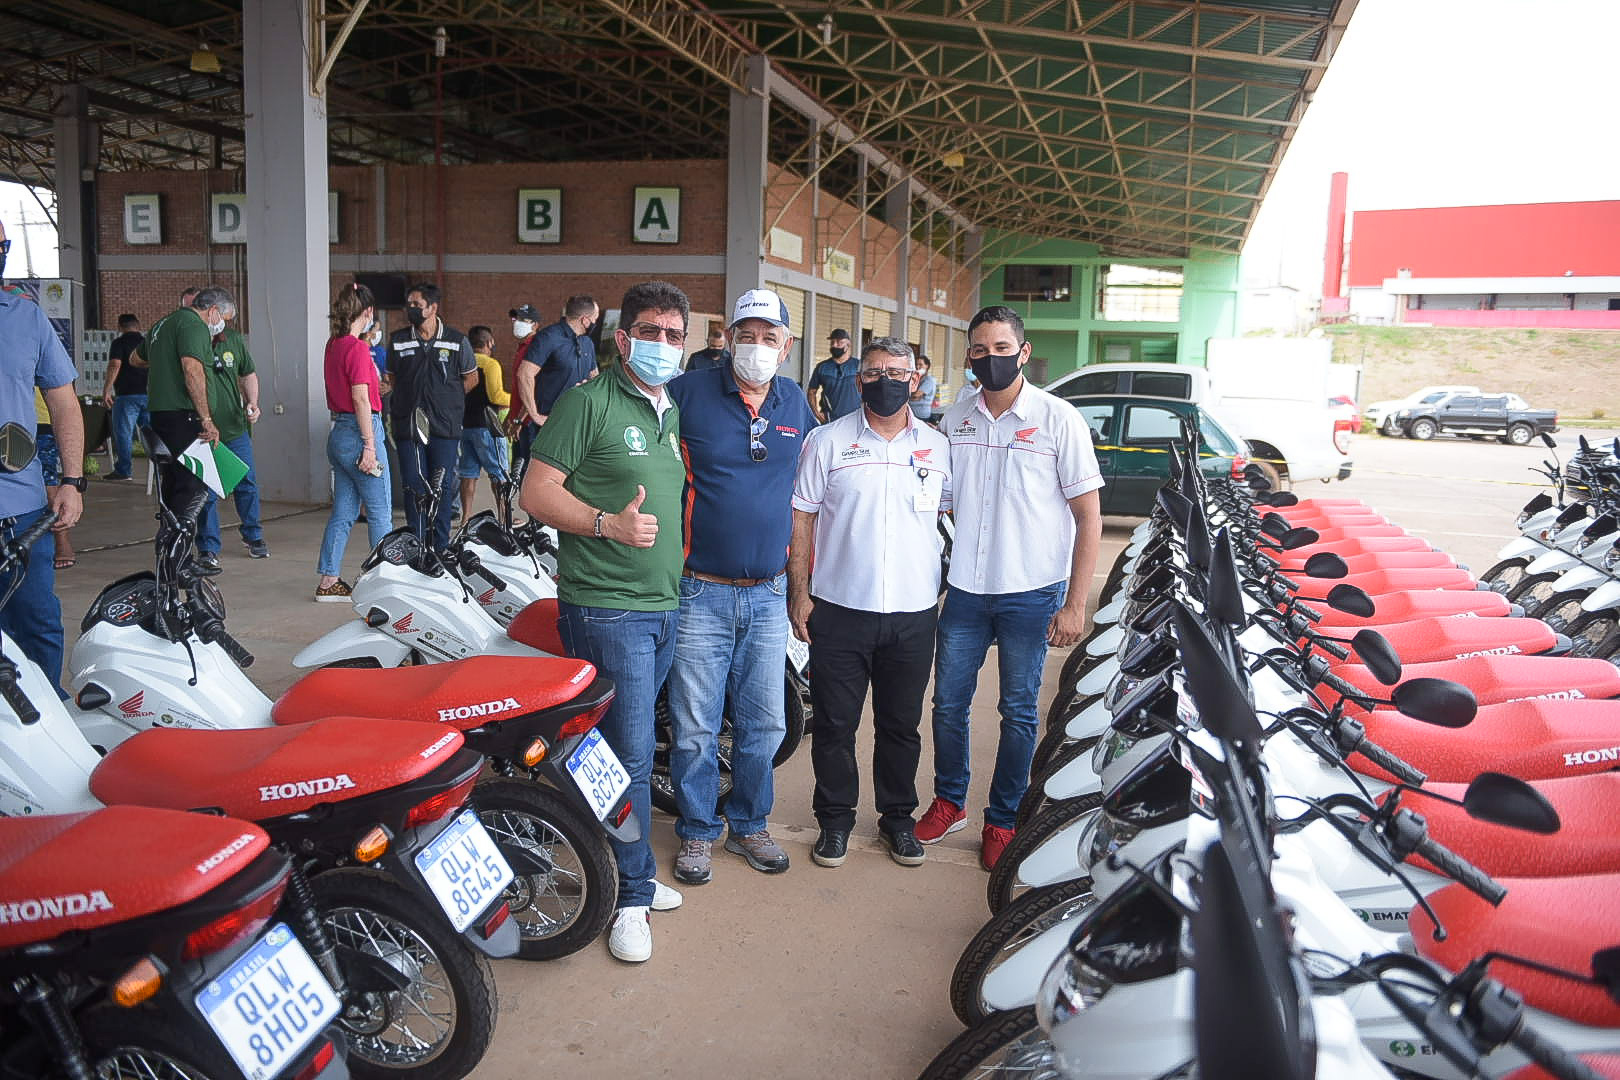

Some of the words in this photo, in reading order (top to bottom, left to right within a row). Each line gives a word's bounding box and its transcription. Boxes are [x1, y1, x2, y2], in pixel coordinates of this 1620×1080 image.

[131, 204, 151, 232] E
[218, 203, 240, 232] D
[526, 198, 552, 230] B
[639, 197, 670, 230] A
[438, 697, 521, 722] HONDA
[420, 731, 458, 759] HONDA
[582, 747, 608, 784] QLW
[259, 774, 355, 802] HONDA
[592, 763, 624, 809] 8C75
[196, 833, 257, 875] HONDA
[440, 835, 482, 883] QLW
[452, 855, 502, 915] 8G45
[0, 890, 113, 923] HONDA
[234, 958, 294, 1025] QLW
[249, 981, 324, 1066] 8H05
